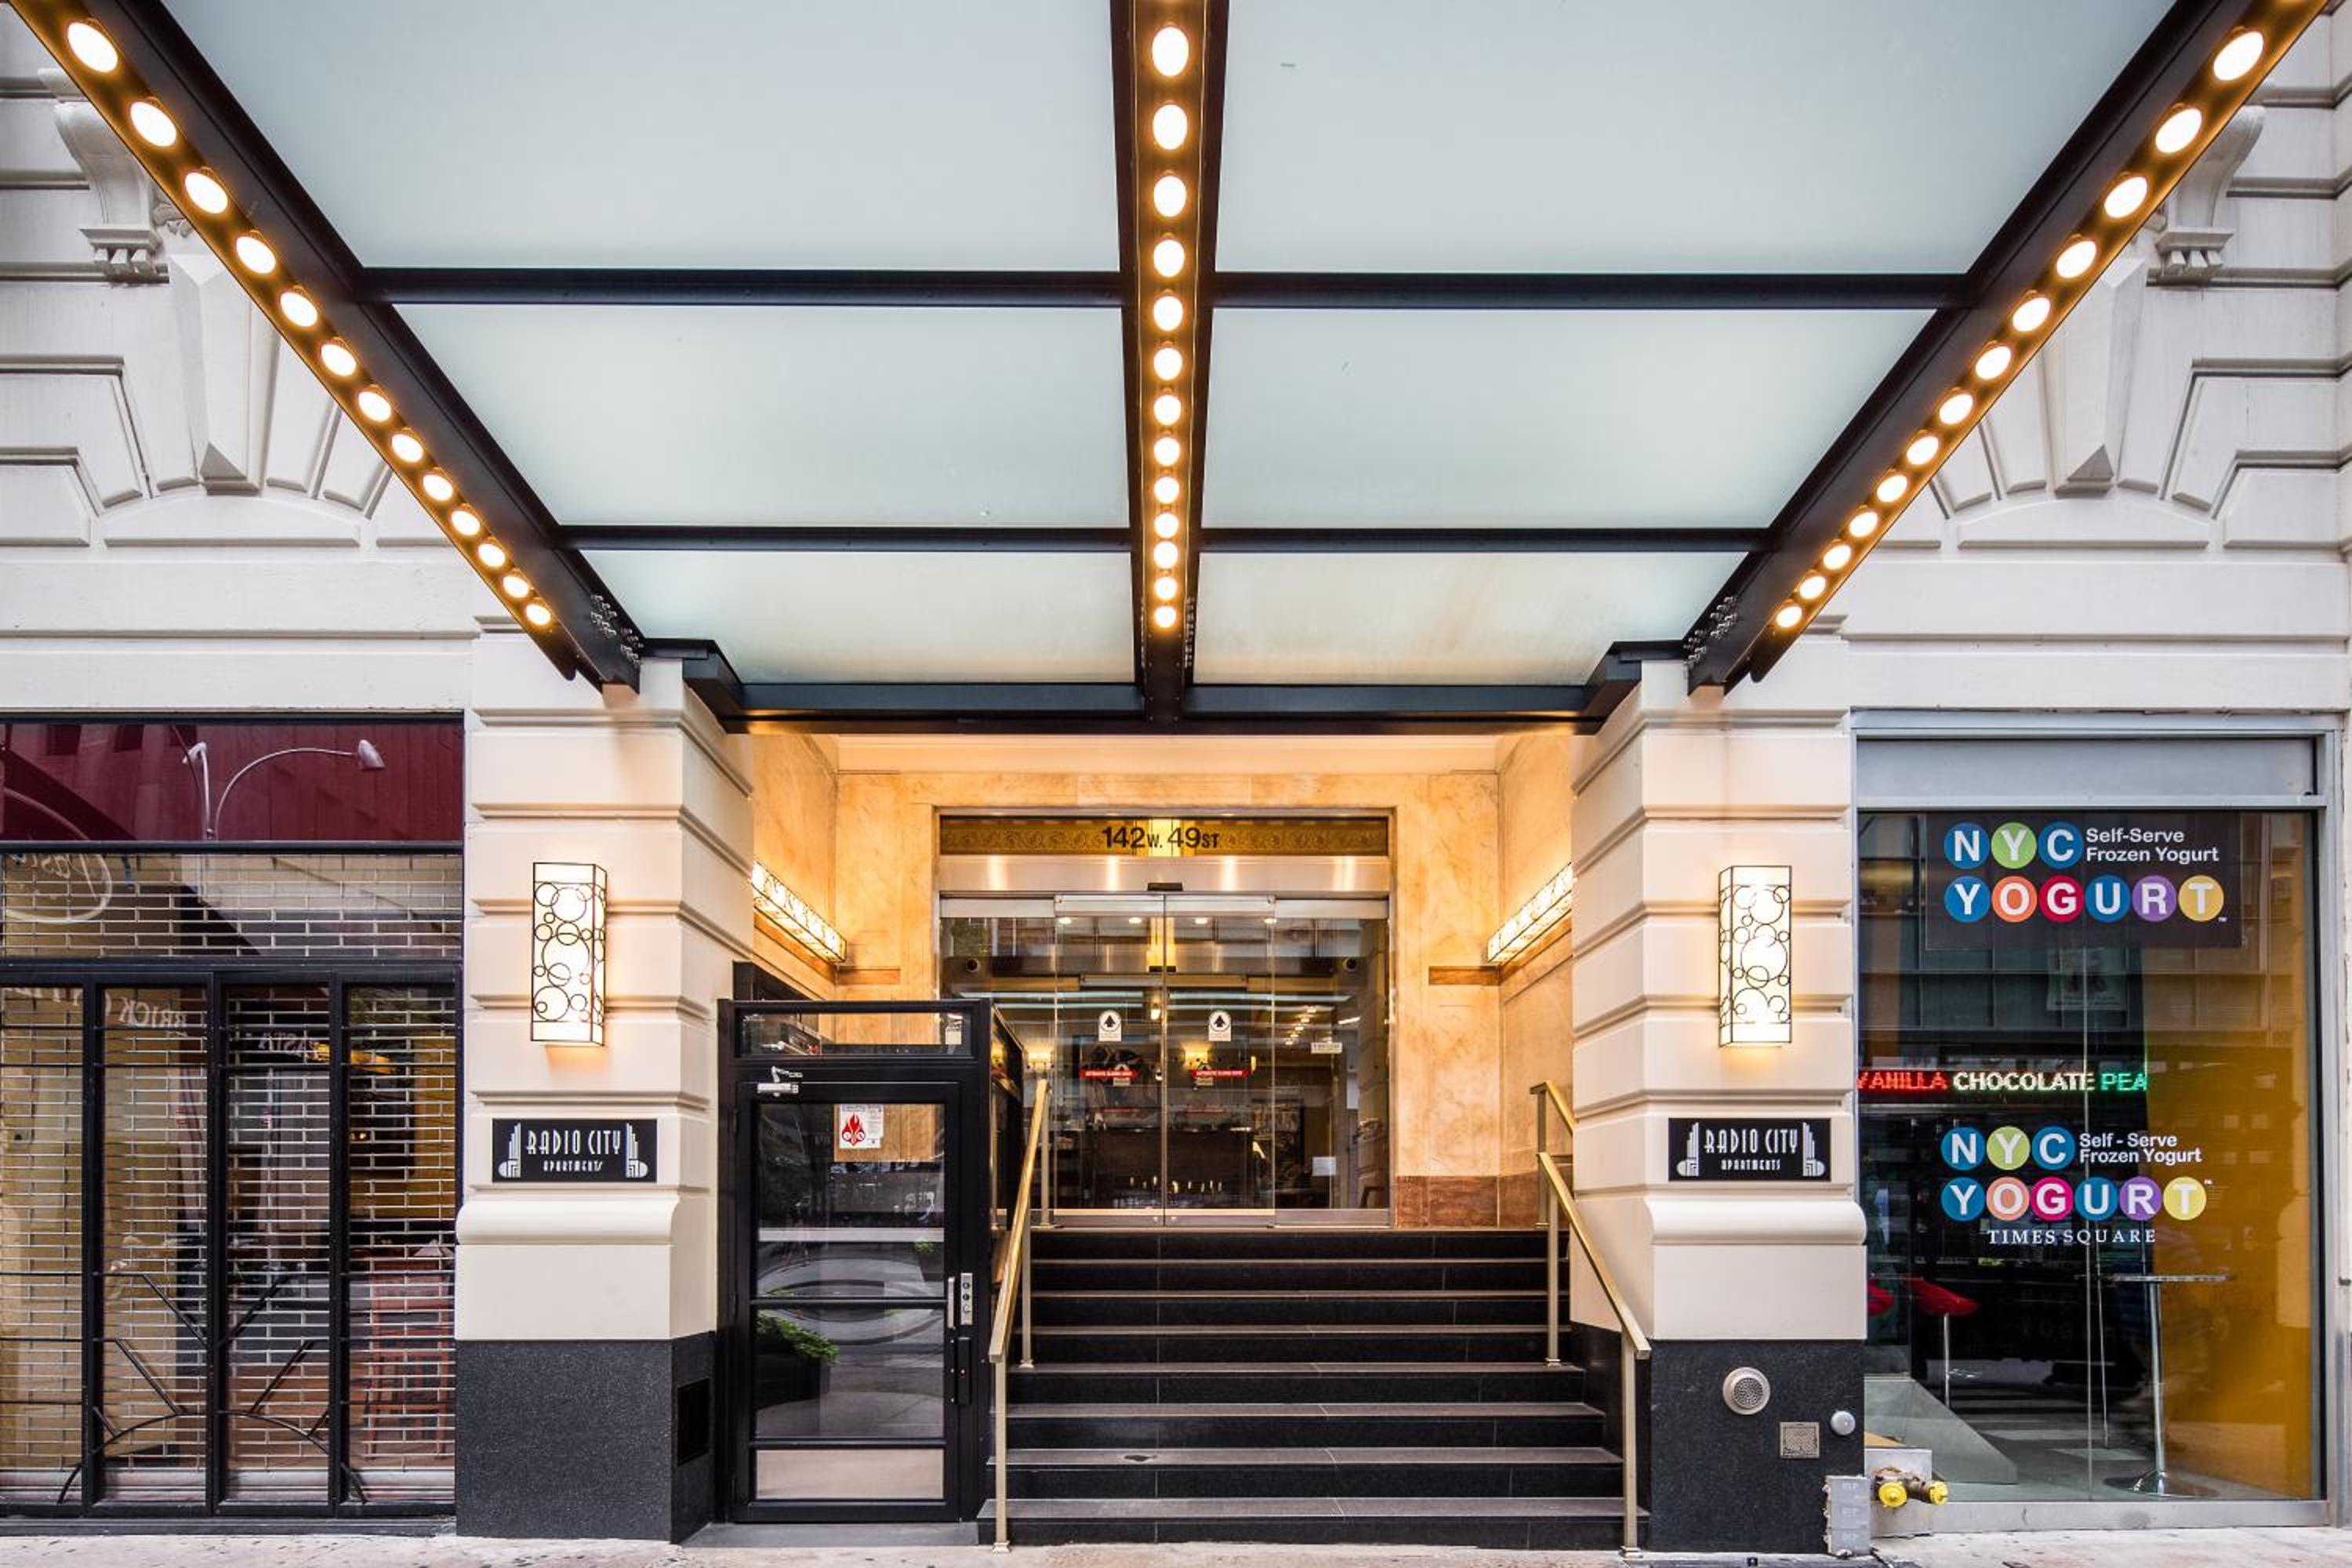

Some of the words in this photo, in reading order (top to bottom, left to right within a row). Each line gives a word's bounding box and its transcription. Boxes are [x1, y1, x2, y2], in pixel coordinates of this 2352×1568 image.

[1953, 828, 2074, 862] NYC
[2085, 828, 2185, 844] Self-Serve
[2085, 847, 2151, 862] Frozen
[2155, 847, 2220, 865] Yogurt
[1953, 881, 2215, 916] YOGURT
[1953, 1071, 2096, 1091] CHOCOLATE
[2100, 1072, 2148, 1091] PEA
[527, 1130, 581, 1155] RADIO
[588, 1130, 622, 1155] CITY
[1704, 1128, 1759, 1154] RADIO
[1765, 1128, 1798, 1154] CITY
[1950, 1132, 2067, 1166] NYC
[2079, 1149, 2140, 1163] Frozen
[2143, 1148, 2202, 1167] Yogurt
[1949, 1182, 2198, 1216] YOGURT
[1987, 1229, 2056, 1245] TIMES
[2062, 1229, 2157, 1246] SQUARE
